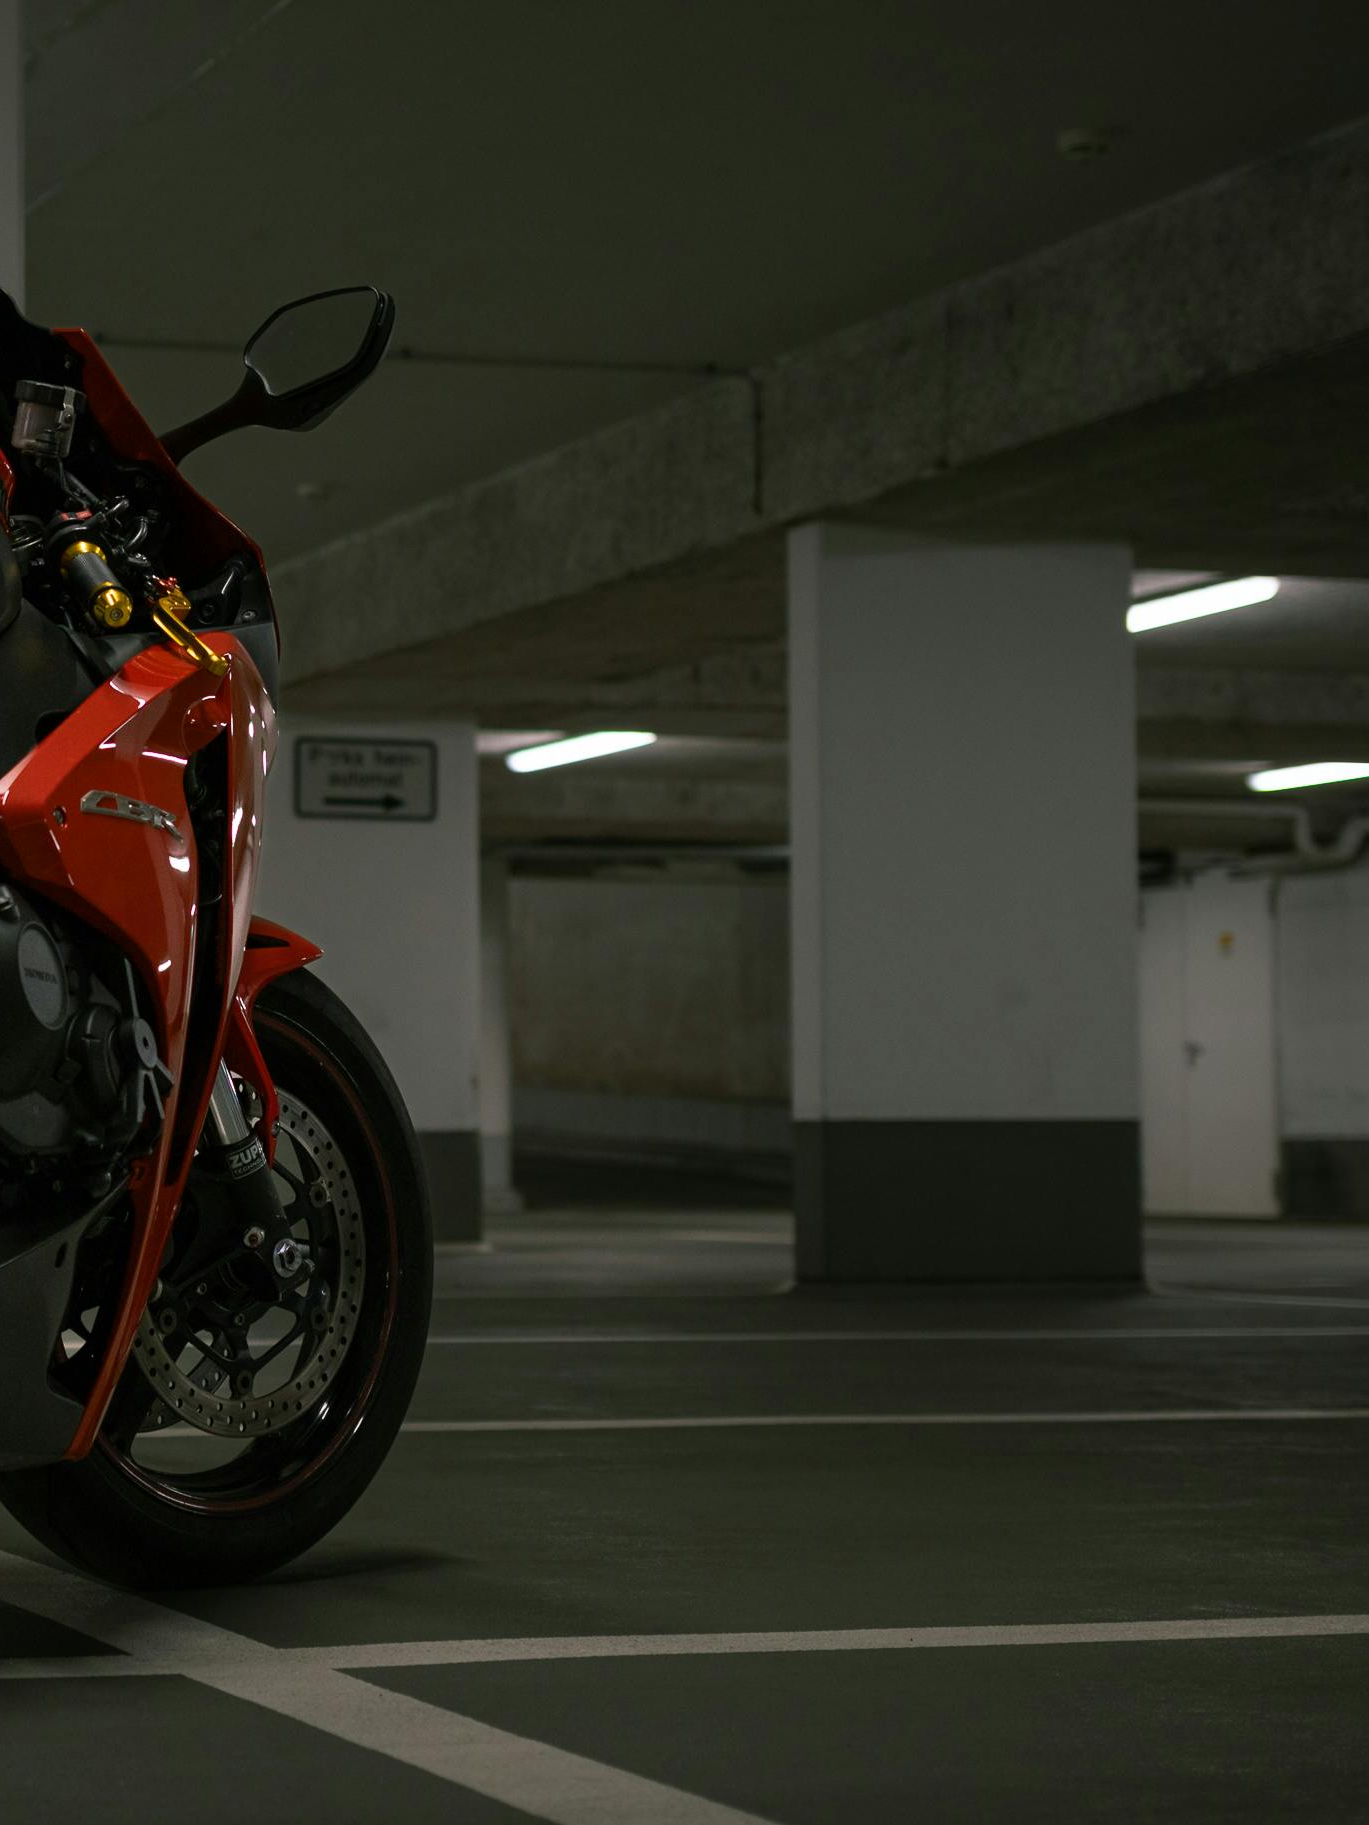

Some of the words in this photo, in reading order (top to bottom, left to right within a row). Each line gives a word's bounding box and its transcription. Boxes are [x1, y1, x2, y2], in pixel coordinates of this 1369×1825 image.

[80, 789, 183, 842] CBR
[23, 967, 57, 985] HONDA
[229, 1143, 259, 1170] ZUP
